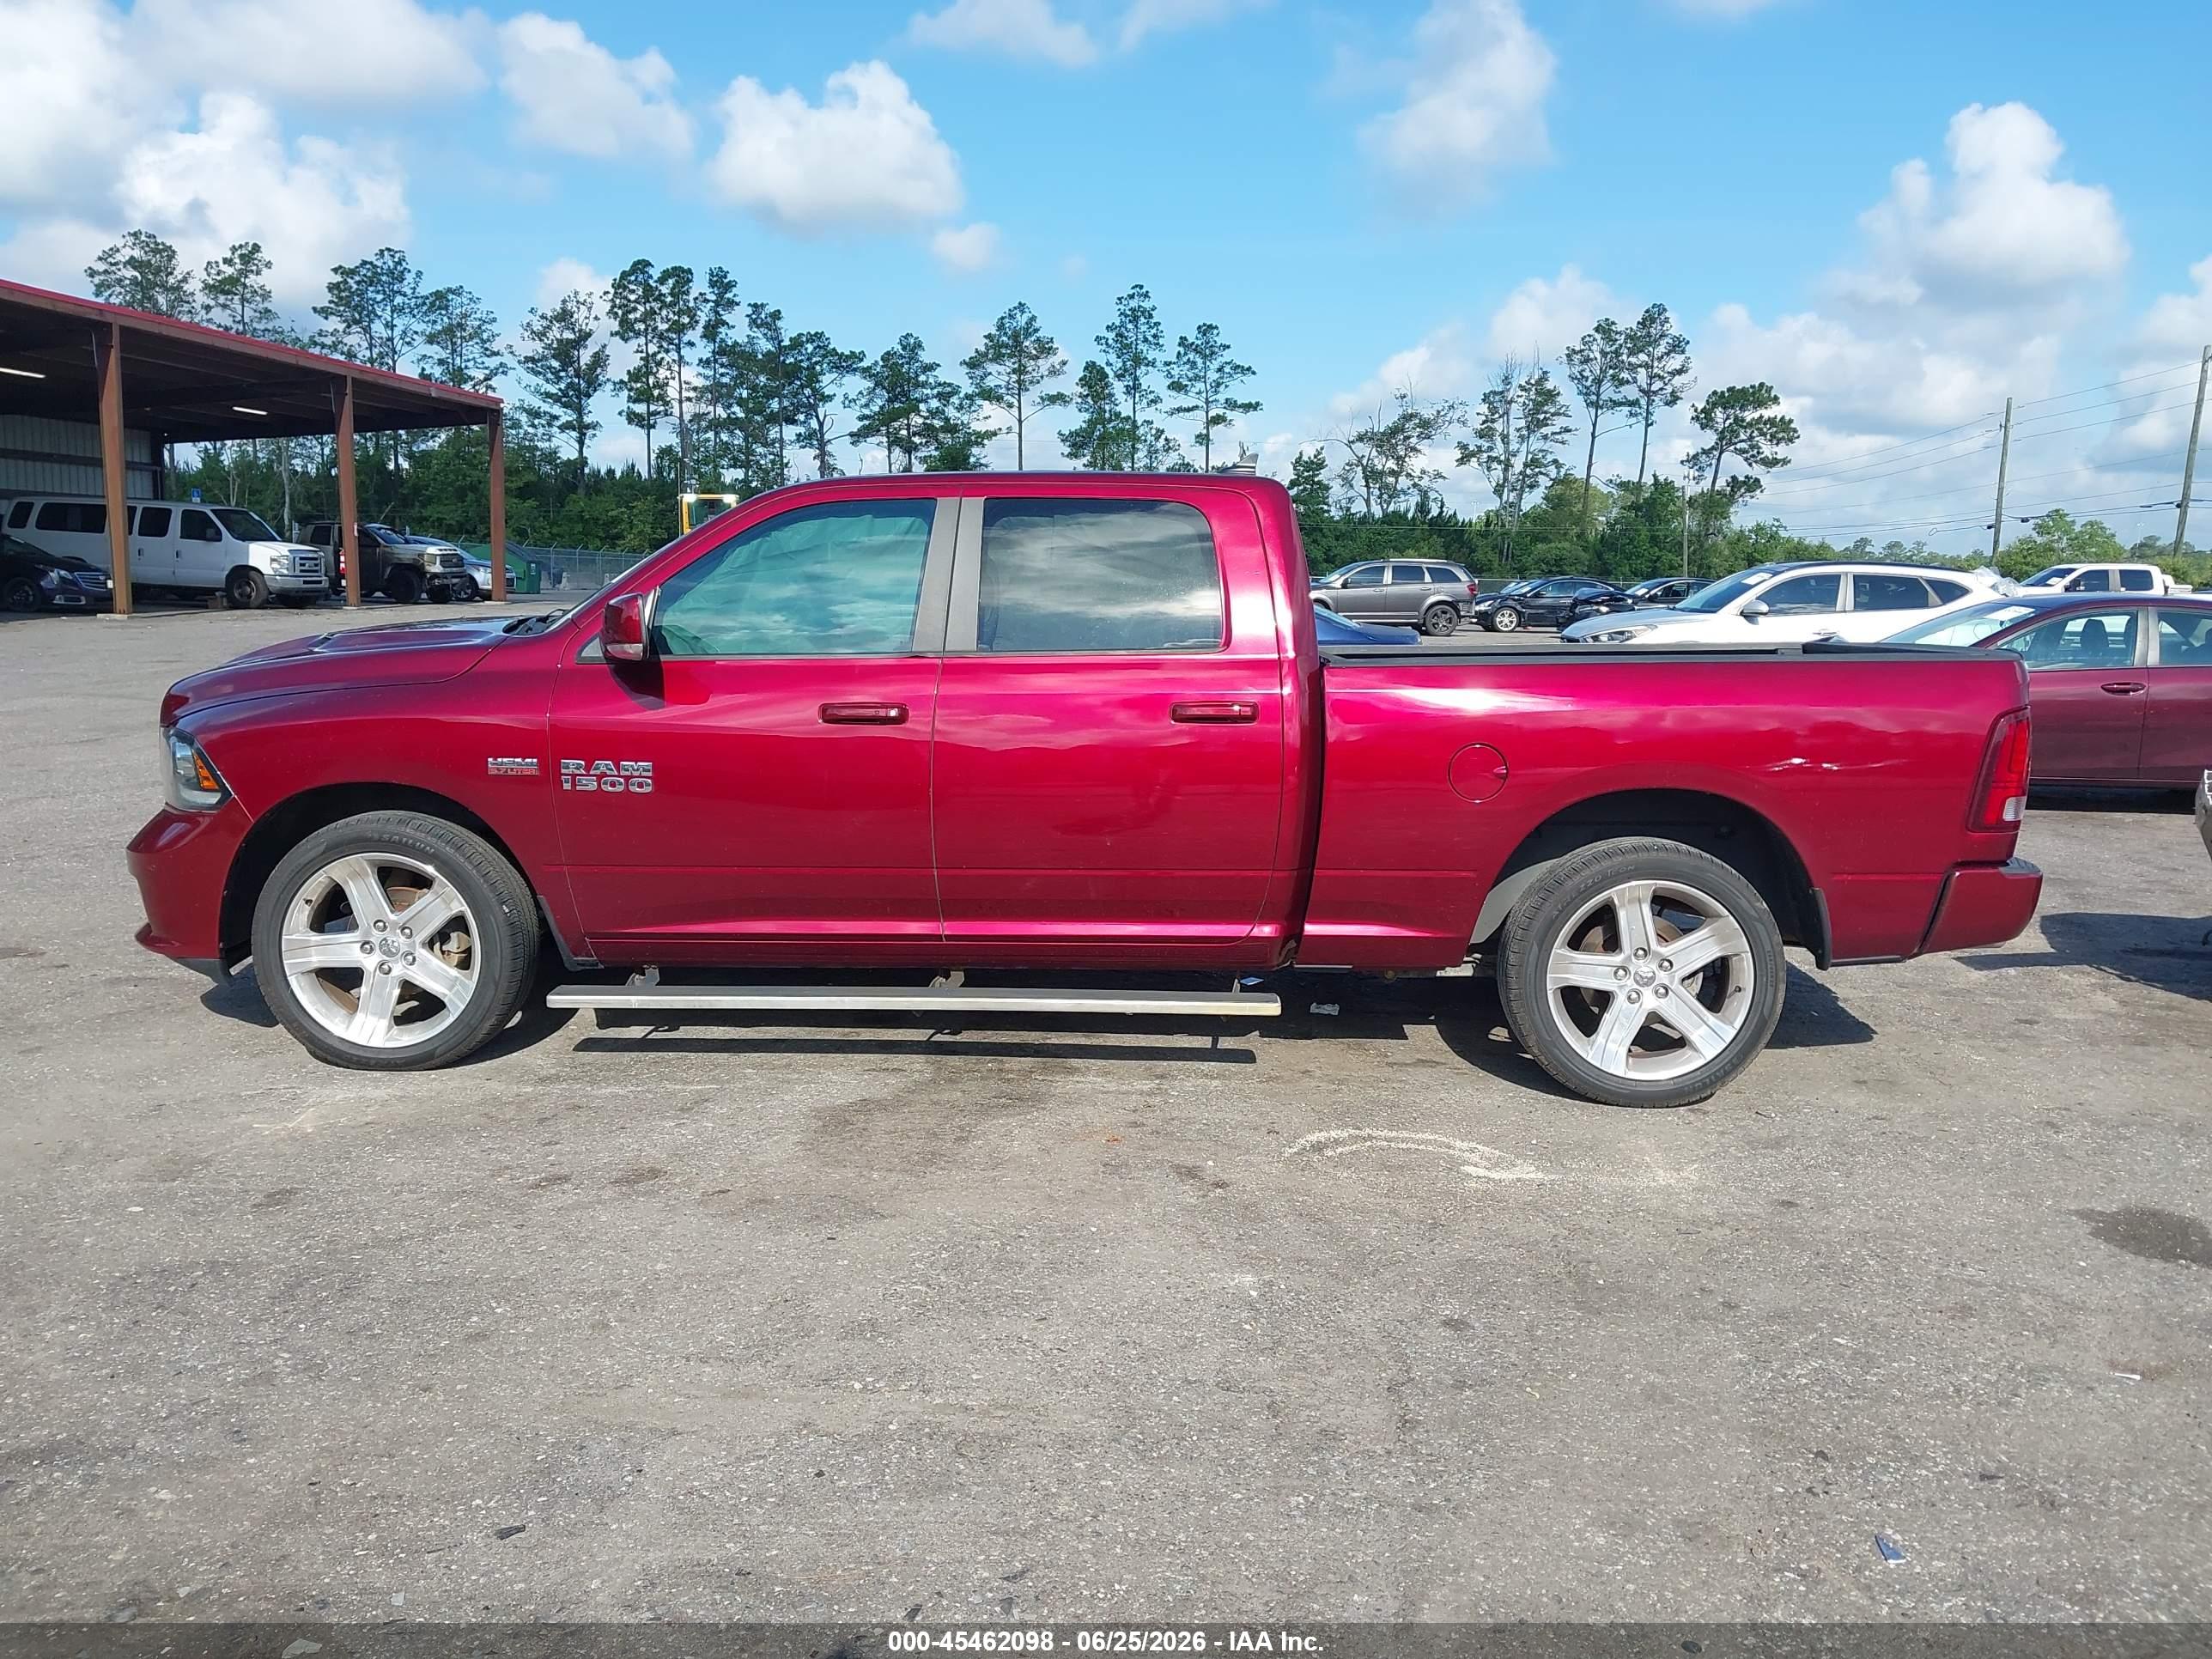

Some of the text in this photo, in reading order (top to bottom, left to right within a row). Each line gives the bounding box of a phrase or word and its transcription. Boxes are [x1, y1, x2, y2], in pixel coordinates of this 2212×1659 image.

[488, 757, 538, 768] HEMI
[561, 759, 653, 776] RAM
[561, 775, 653, 793] 1500
